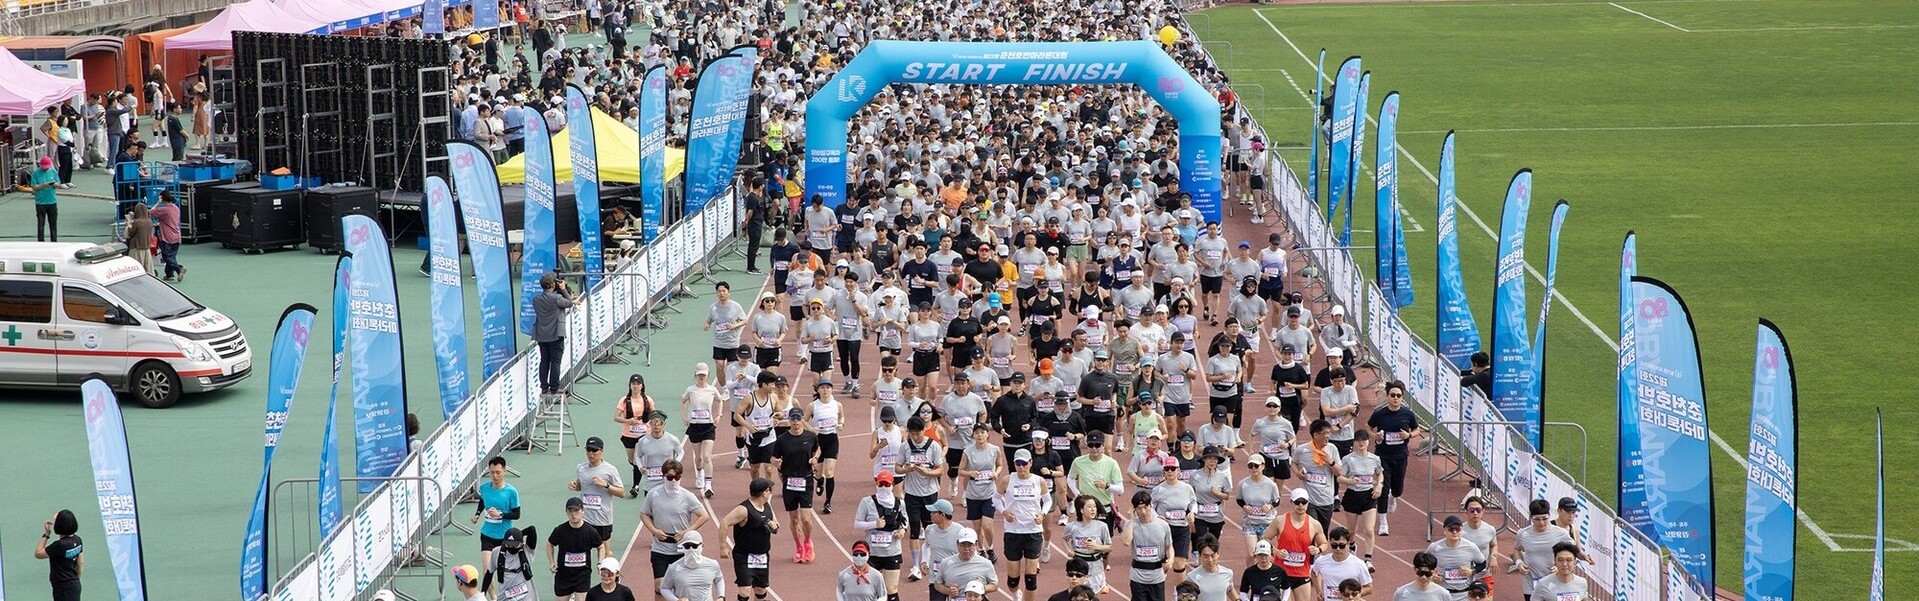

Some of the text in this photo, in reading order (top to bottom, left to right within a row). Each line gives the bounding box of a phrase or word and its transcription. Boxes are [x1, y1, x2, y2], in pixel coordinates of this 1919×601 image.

[901, 62, 1128, 81] START FINISH
[1017, 487, 1032, 495] 7372
[1288, 553, 1303, 562] 7014
